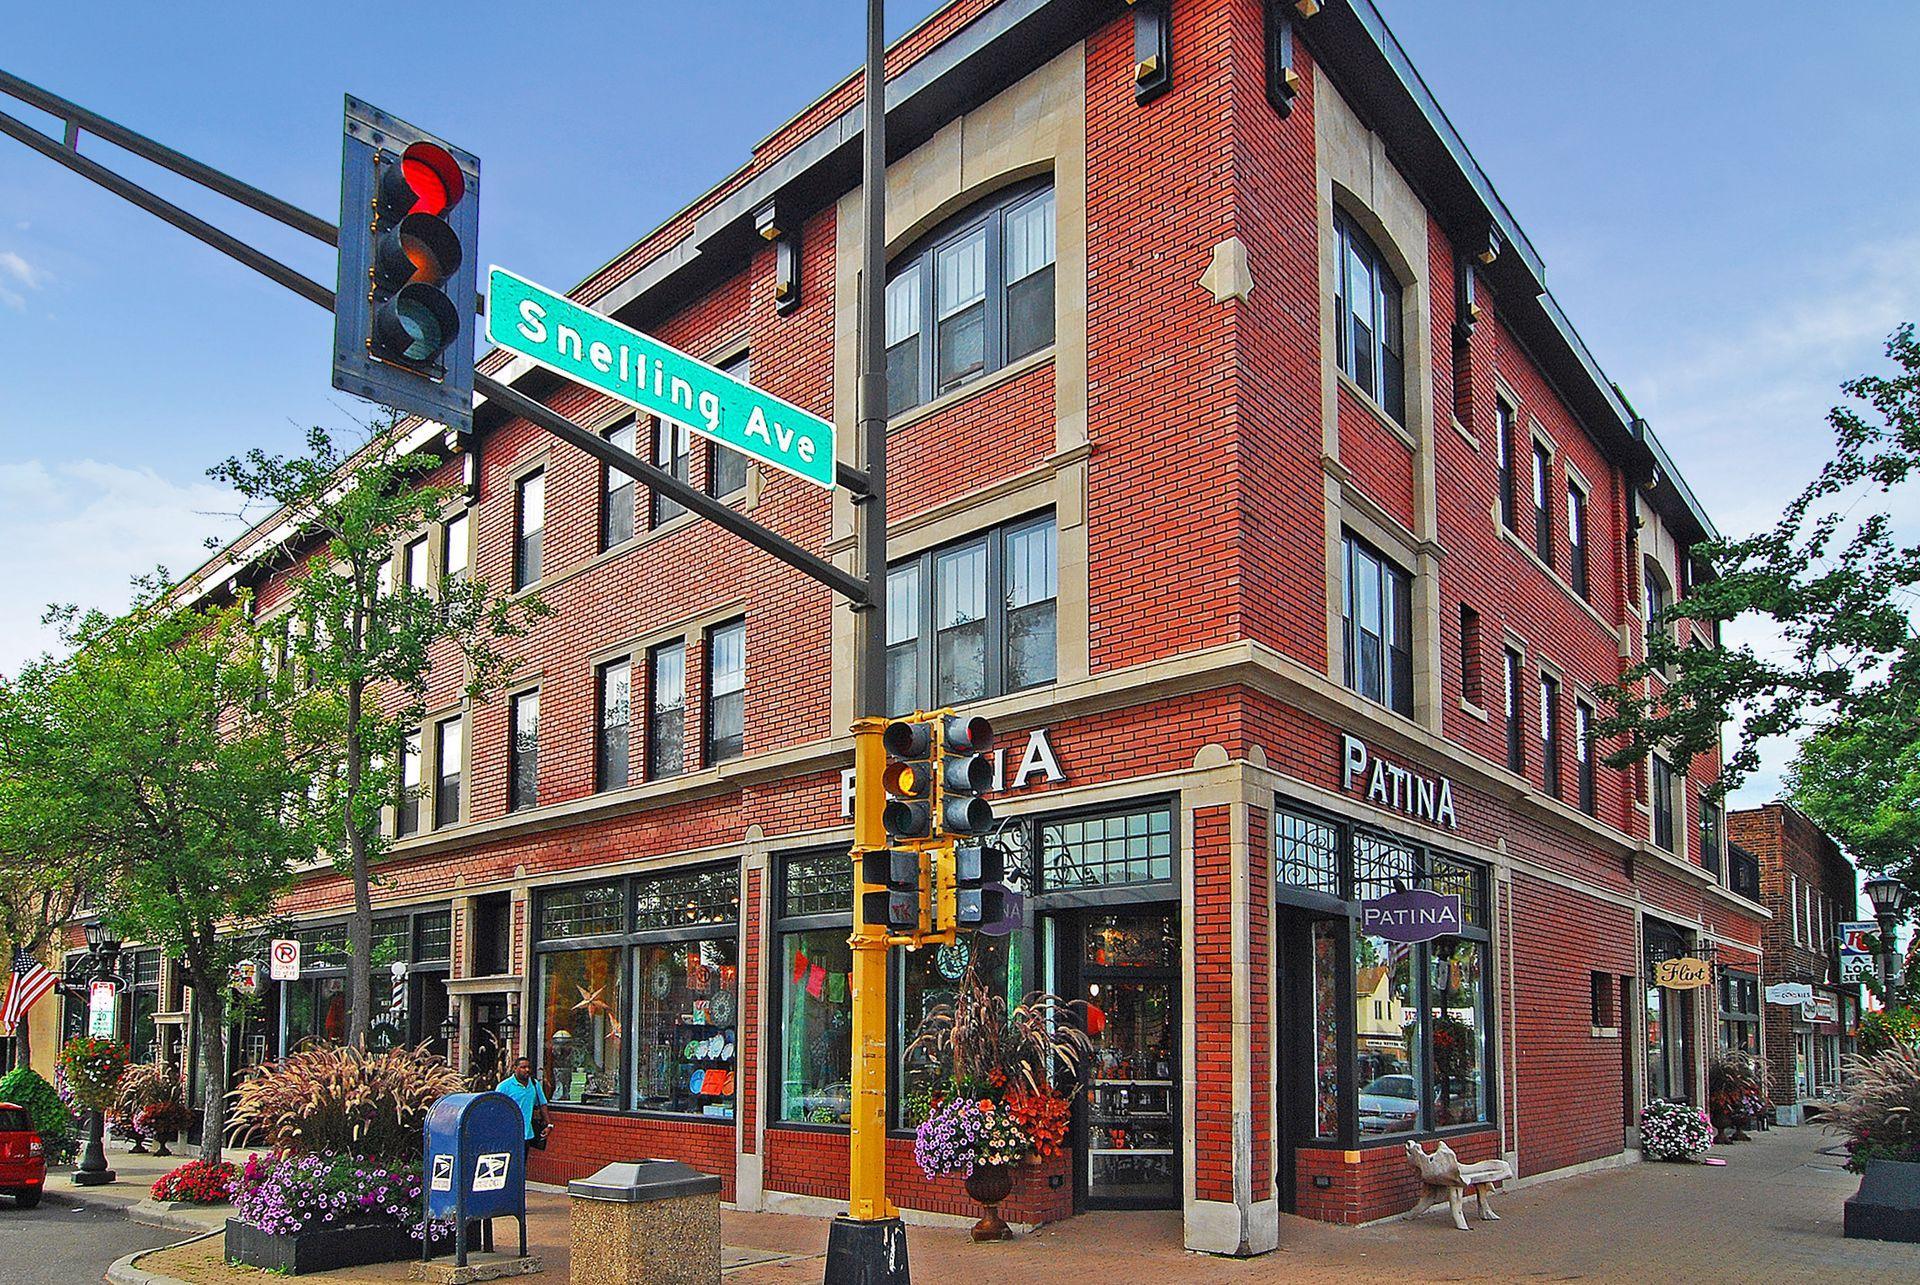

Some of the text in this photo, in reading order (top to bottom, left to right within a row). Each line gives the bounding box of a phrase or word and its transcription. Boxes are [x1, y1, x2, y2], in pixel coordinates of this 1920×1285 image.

[517, 298, 817, 463] Snelling Ave
[1341, 732, 1458, 831] PATINA
[1364, 905, 1457, 926] PATINA
[1661, 962, 1705, 982] Flirt
